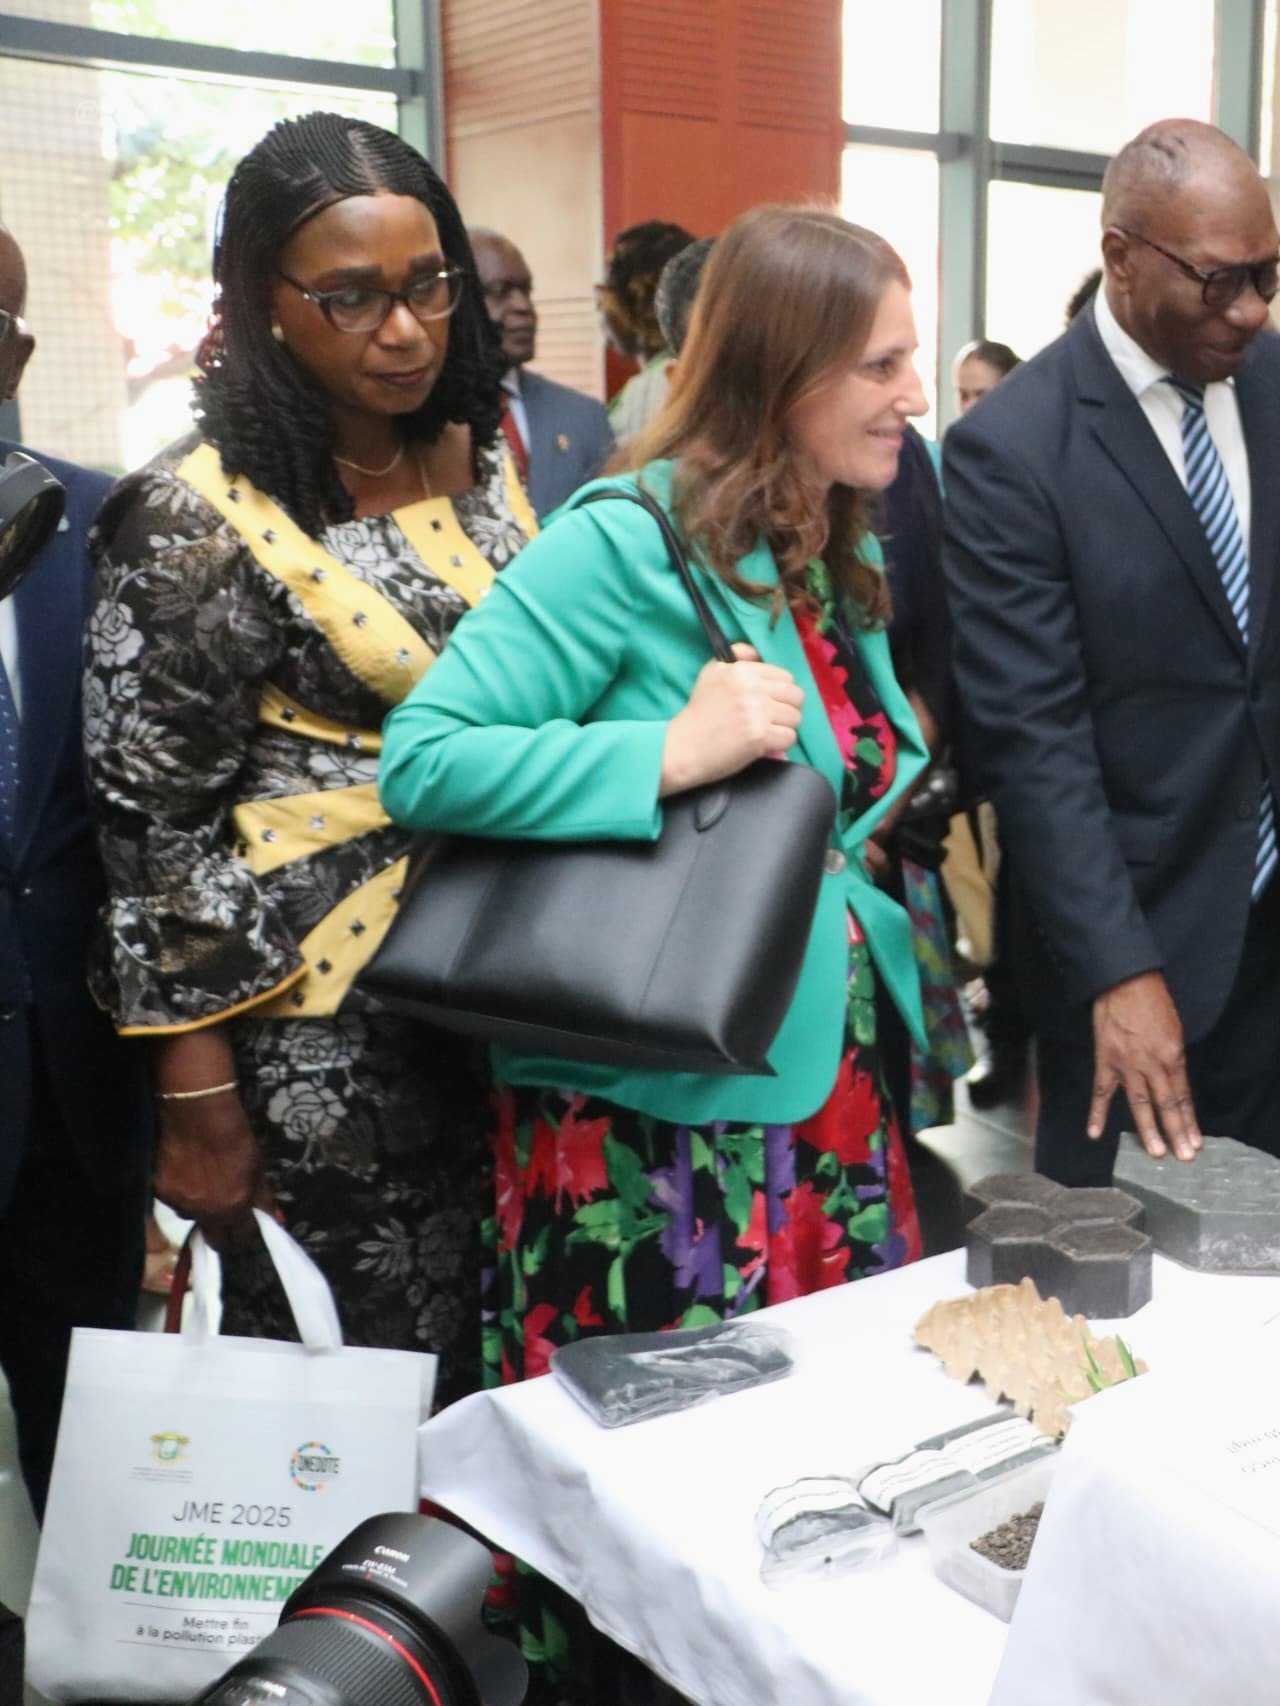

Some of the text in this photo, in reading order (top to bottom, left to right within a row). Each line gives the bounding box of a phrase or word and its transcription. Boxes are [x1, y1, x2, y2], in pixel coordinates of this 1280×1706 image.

[172, 1500, 293, 1528] JME 2025
[125, 1532, 324, 1571] JOURNÉE MONDIALE
[109, 1563, 140, 1593] DE
[141, 1567, 305, 1602] L'ENVIRONNEM
[148, 1625, 160, 1638] la
[162, 1627, 224, 1645] pollution
[227, 1632, 263, 1647] plast
[182, 1616, 250, 1632] Mettre fin
